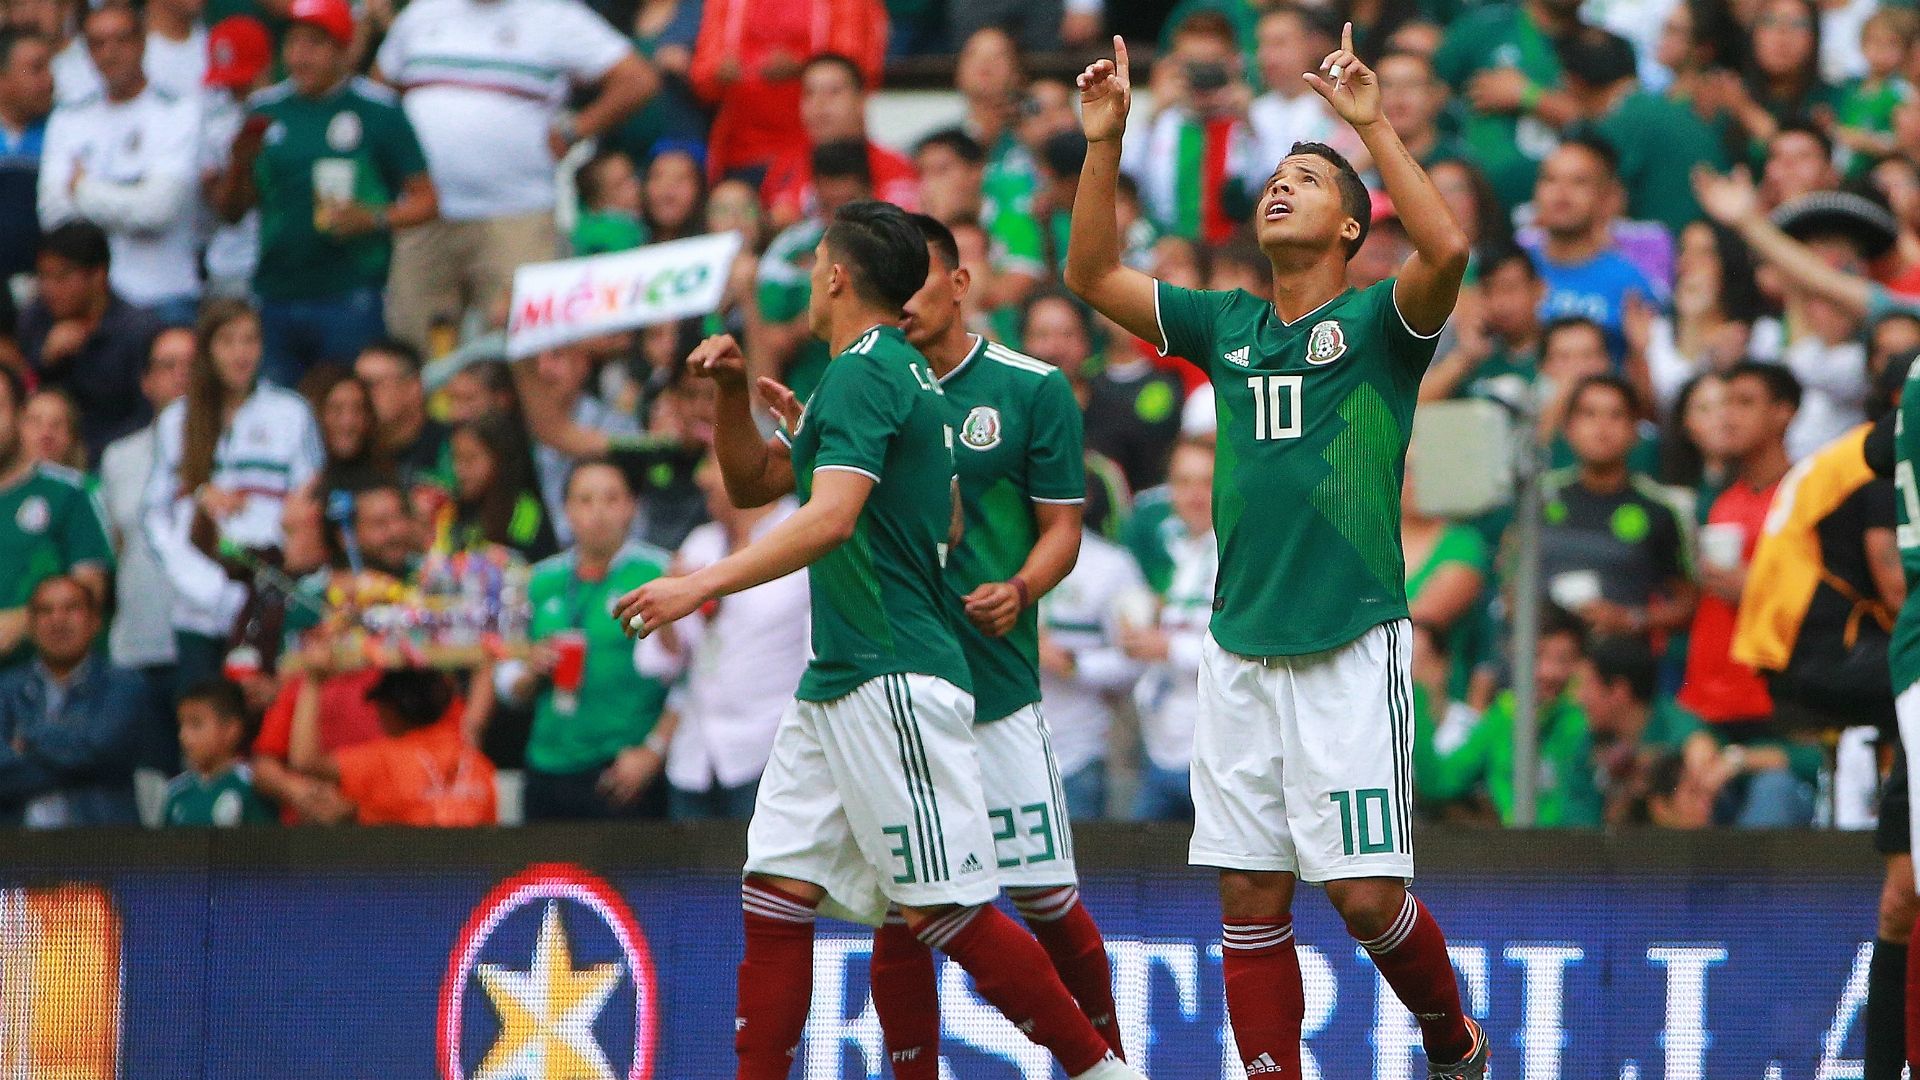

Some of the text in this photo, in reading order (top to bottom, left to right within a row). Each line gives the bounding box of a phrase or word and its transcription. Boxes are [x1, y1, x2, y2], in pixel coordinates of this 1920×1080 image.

[1224, 353, 1249, 368] adidas
[1247, 376, 1303, 440] 10
[987, 802, 1056, 870] 23
[1329, 788, 1394, 856] 10
[880, 824, 917, 885] 3
[892, 1046, 922, 1063] FMF
